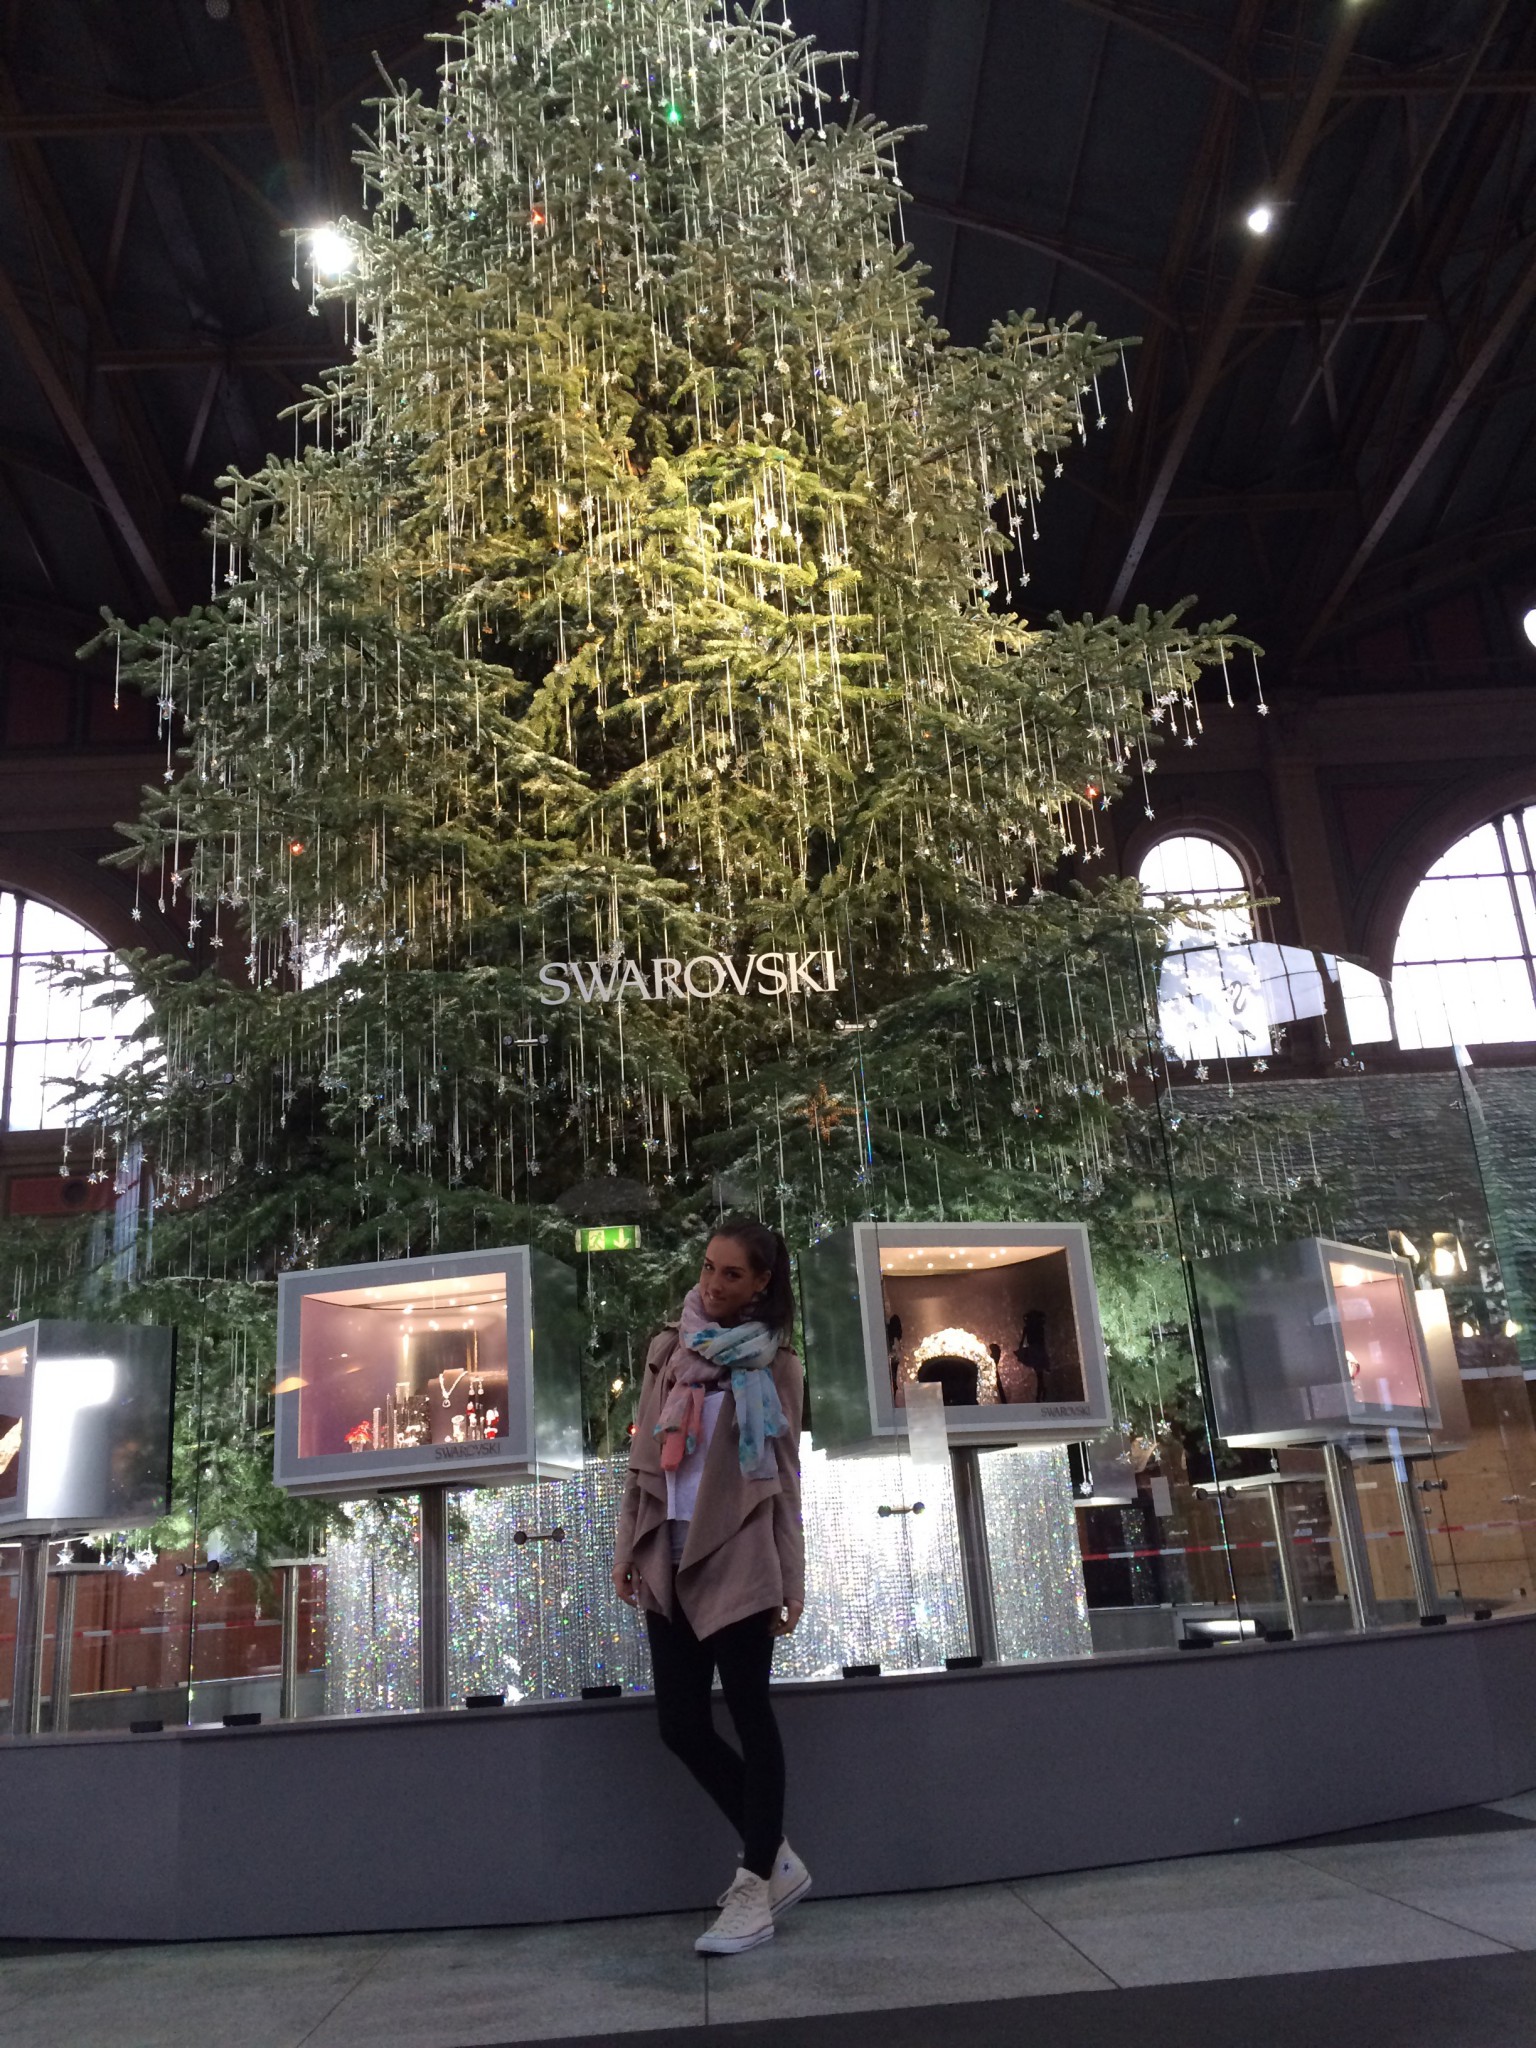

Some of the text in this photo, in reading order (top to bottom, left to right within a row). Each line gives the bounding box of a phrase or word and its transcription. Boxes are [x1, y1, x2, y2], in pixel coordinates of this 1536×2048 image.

[538, 950, 839, 1005] SWAROVSKI
[1040, 1406, 1091, 1418] SWAROVSKI
[435, 1442, 501, 1460] SWAROVSKI
